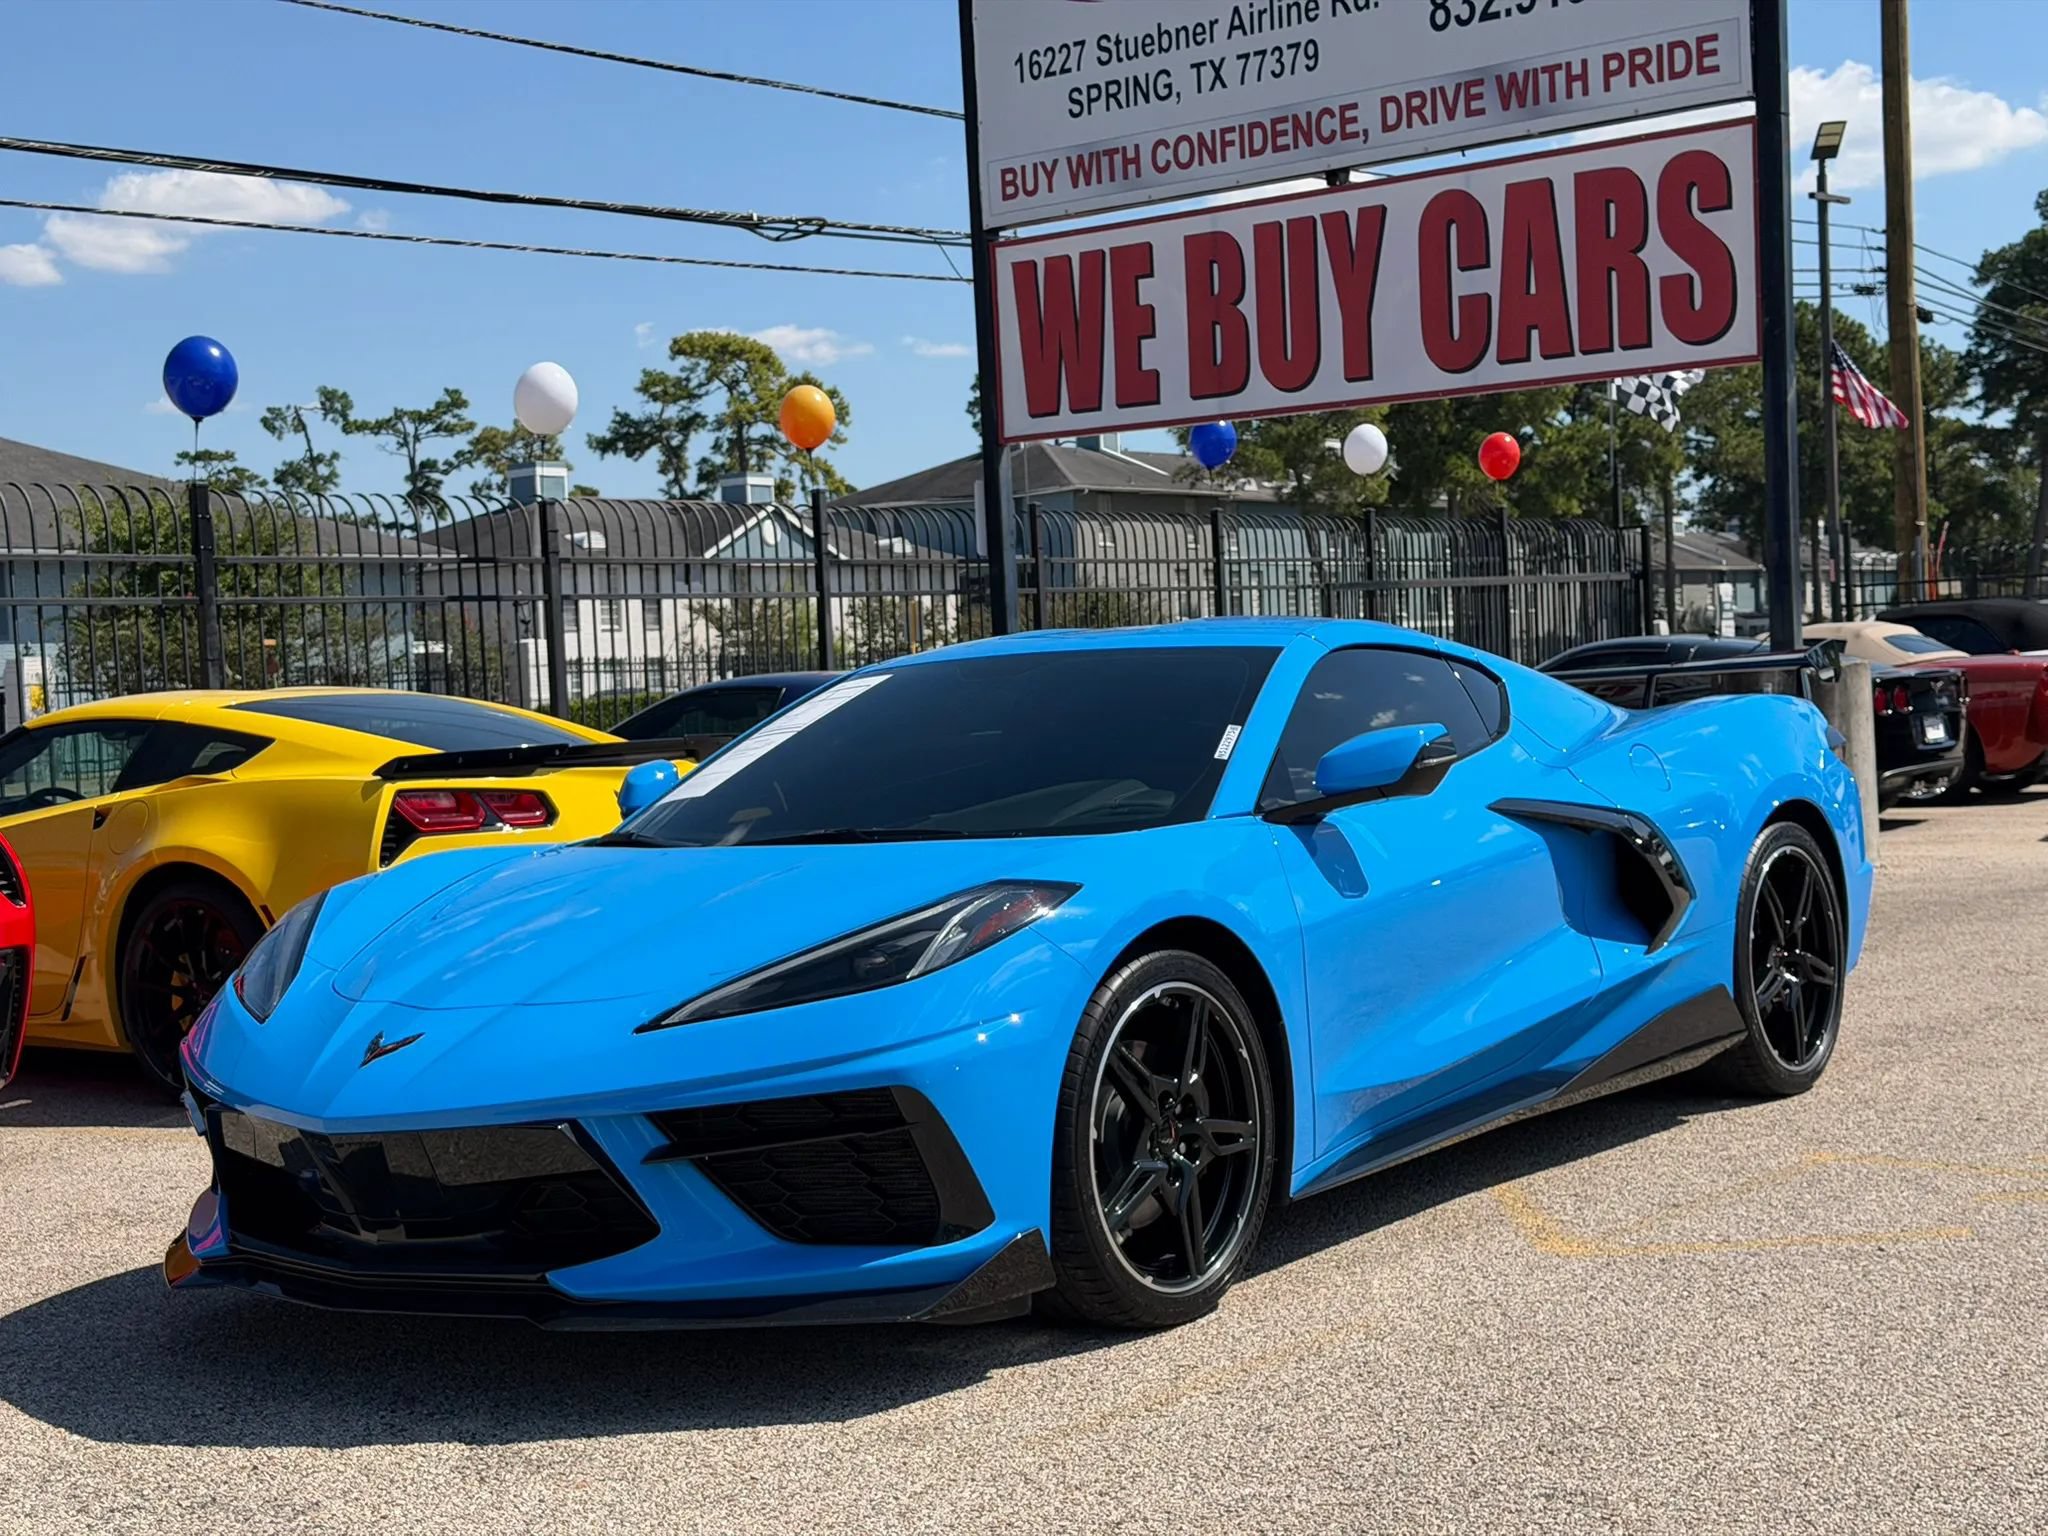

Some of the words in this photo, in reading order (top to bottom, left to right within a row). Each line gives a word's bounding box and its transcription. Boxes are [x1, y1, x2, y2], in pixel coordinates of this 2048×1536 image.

[1014, 39, 1086, 84] 16227
[1096, 18, 1219, 67] Stuebner
[1226, 0, 1320, 40] Airline
[1068, 69, 1182, 119] SPRING,
[1190, 57, 1228, 94] TX
[1236, 38, 1320, 86] 77379
[1000, 158, 1059, 202] BUY
[1066, 143, 1142, 191] WITH
[1151, 102, 1370, 175] CONFIDENCE,
[1380, 78, 1486, 134] DRIVE
[1495, 58, 1589, 112] WITH
[1603, 33, 1720, 93] PRIDE
[1011, 241, 1161, 419] WE
[1184, 204, 1388, 400] BUY
[1418, 149, 1739, 375] CARS
